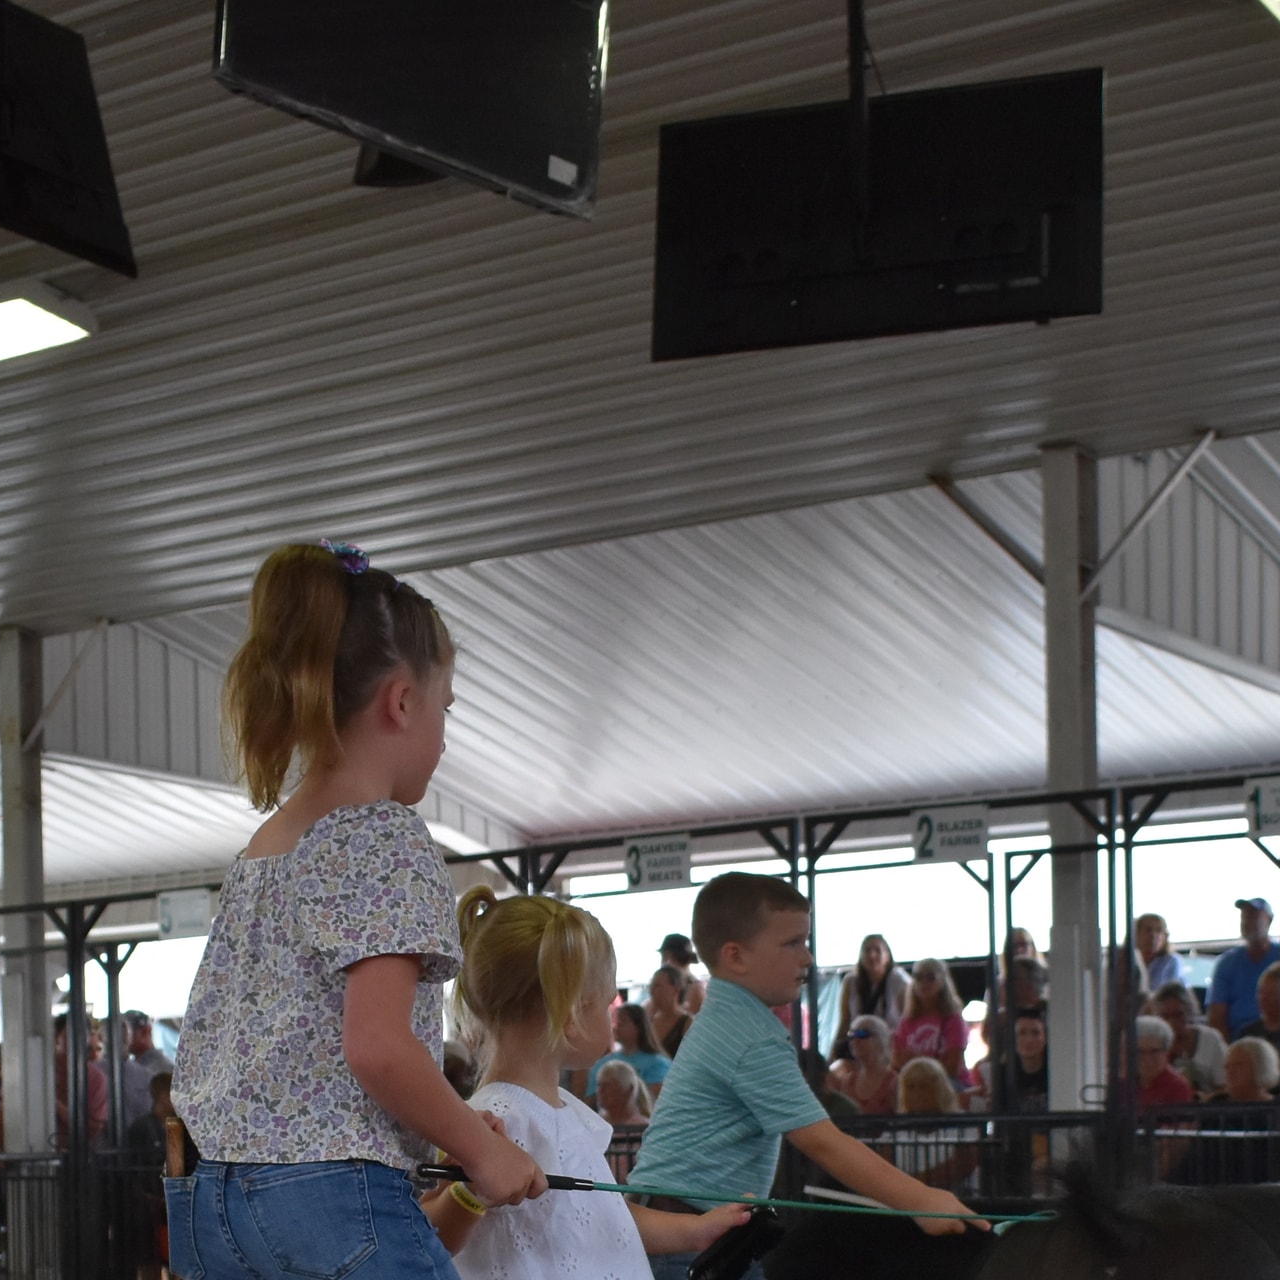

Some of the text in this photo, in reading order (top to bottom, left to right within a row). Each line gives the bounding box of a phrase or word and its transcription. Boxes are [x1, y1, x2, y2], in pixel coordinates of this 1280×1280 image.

[1248, 786, 1261, 831] 1
[917, 815, 934, 858] 2
[936, 819, 983, 832] BLAZER
[940, 834, 981, 847] FARMS
[627, 845, 642, 886] 3
[648, 870, 683, 882] MEATS
